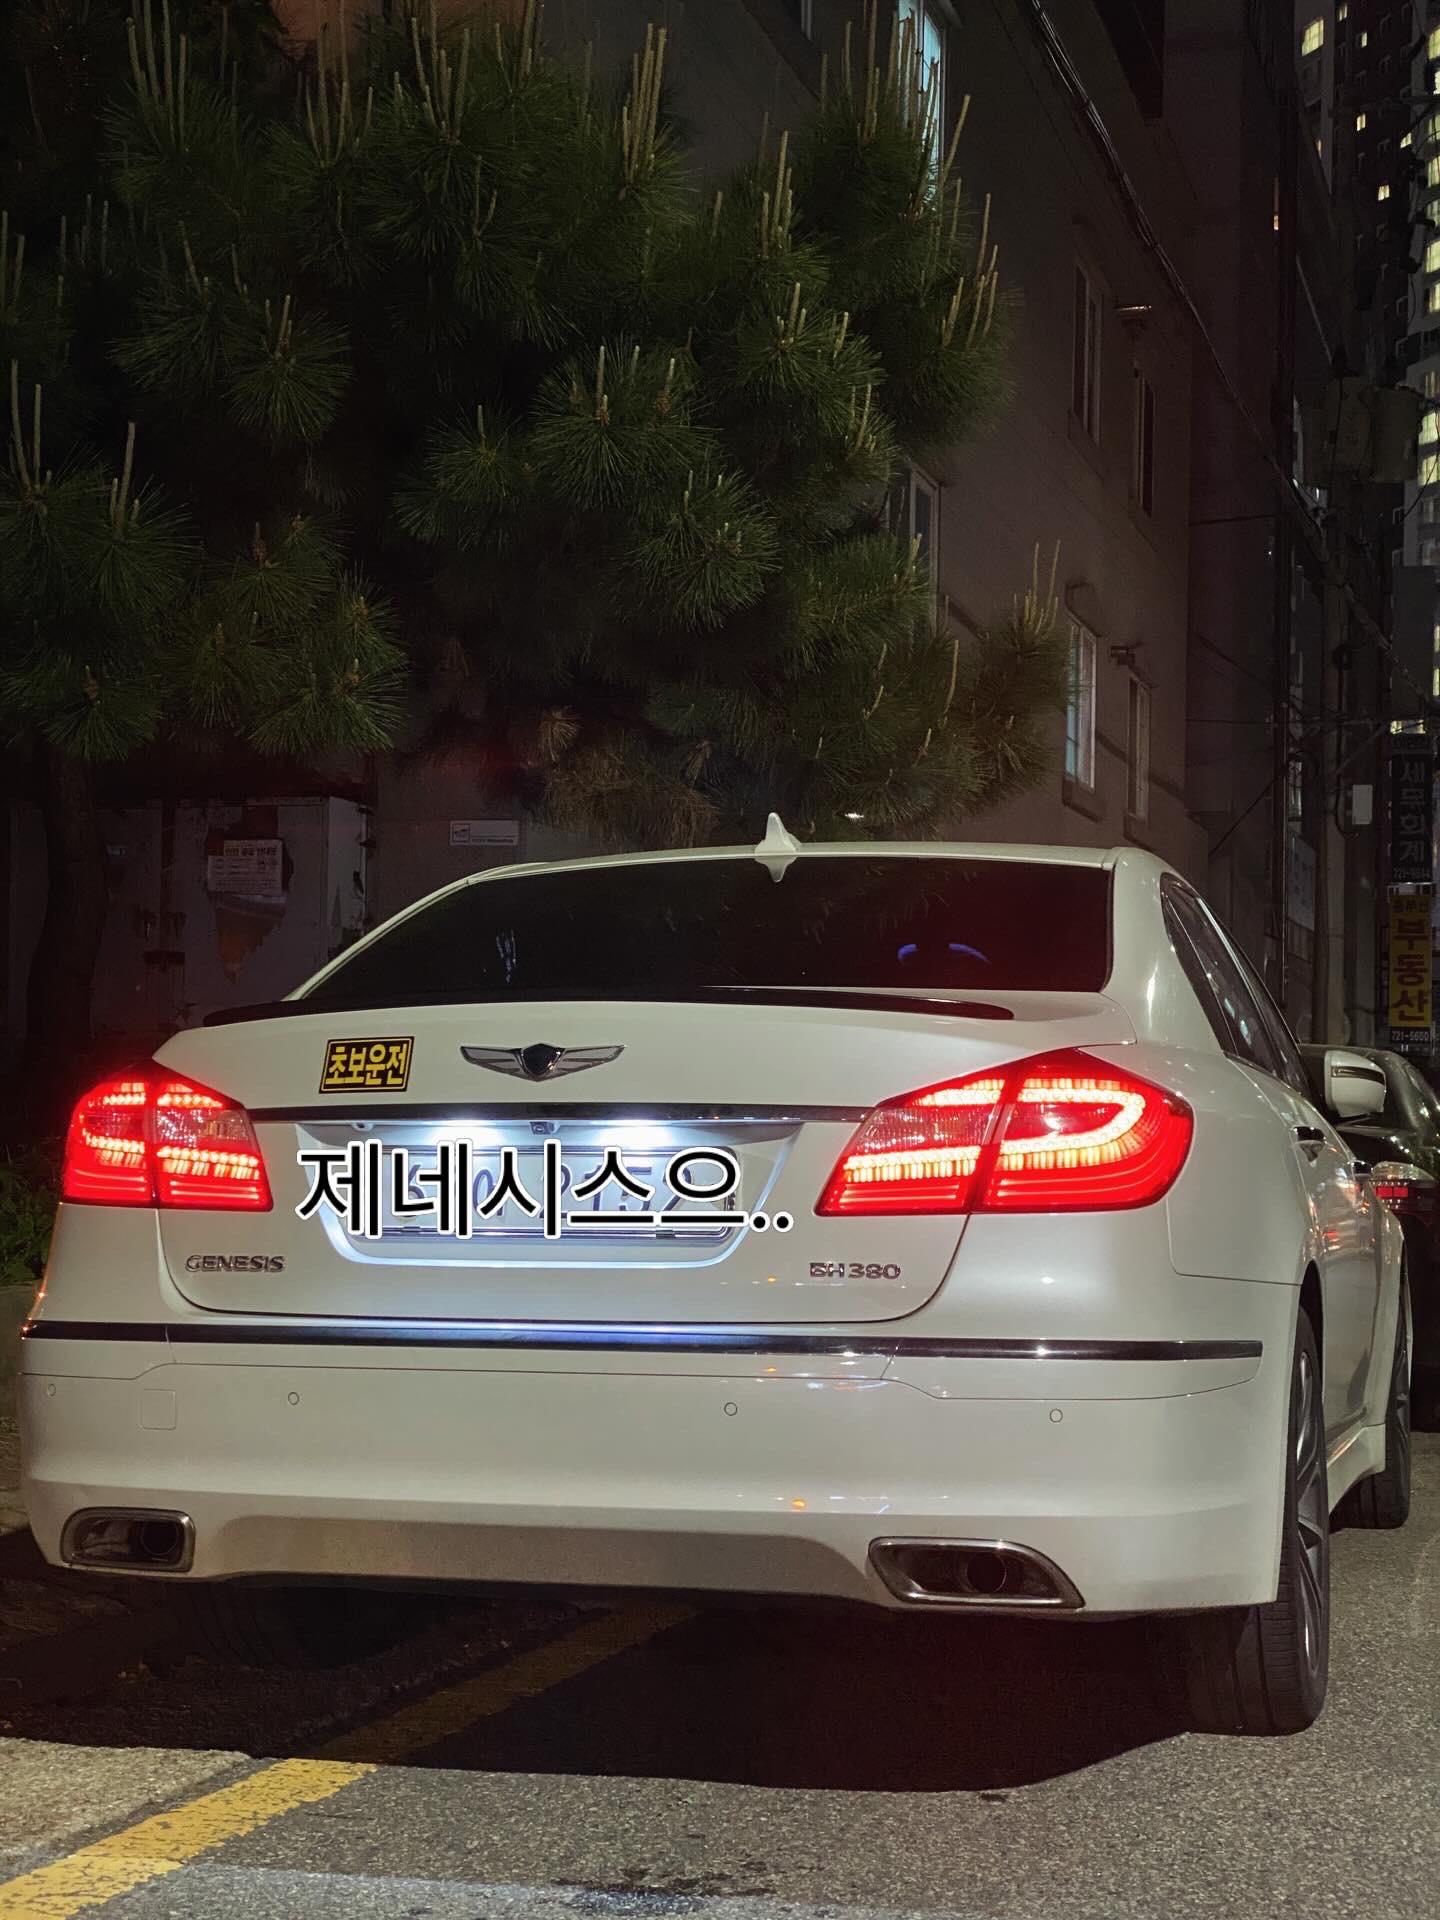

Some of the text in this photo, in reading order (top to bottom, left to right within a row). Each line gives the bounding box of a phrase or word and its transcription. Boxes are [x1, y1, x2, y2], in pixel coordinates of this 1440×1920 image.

[1392, 917, 1429, 1022] 부동산
[325, 1043, 407, 1085] 초보운전
[185, 1254, 285, 1272] GENESIS
